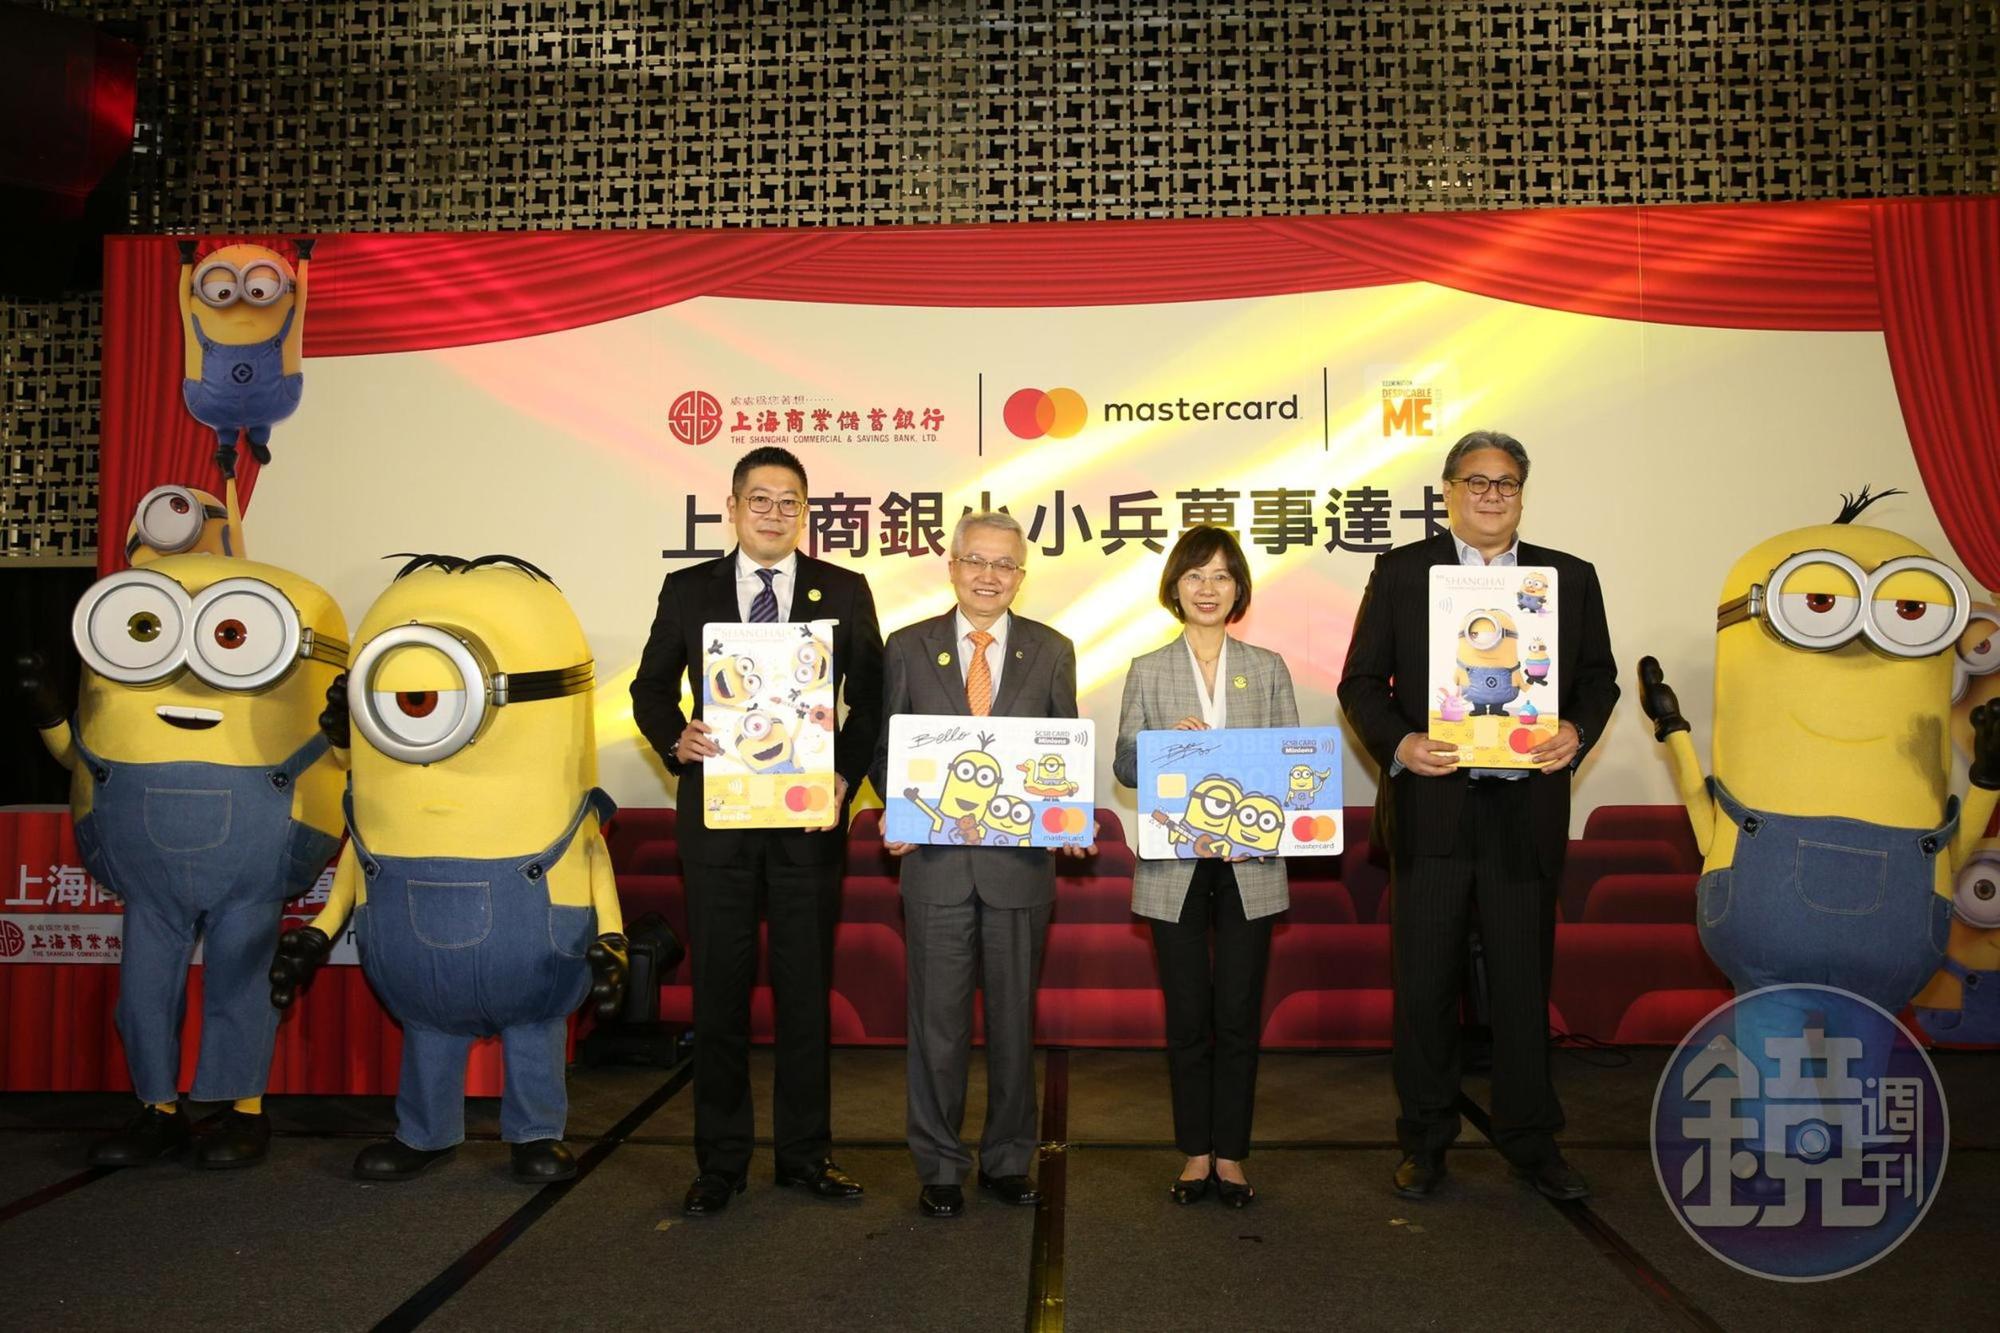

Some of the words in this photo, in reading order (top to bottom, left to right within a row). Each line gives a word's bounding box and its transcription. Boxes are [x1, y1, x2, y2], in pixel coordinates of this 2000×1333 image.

[1382, 389, 1432, 398] DESPICABLE
[730, 408, 945, 433] 上海商業儲蓄銀行
[1104, 394, 1298, 422] mastercard
[1383, 398, 1433, 437] ME
[750, 435, 789, 443] SHANGHAI
[793, 435, 842, 443] COMMERCIAL
[857, 434, 889, 443] SAVINGS
[662, 486, 1448, 558] 上商銀小兵萬事達卡
